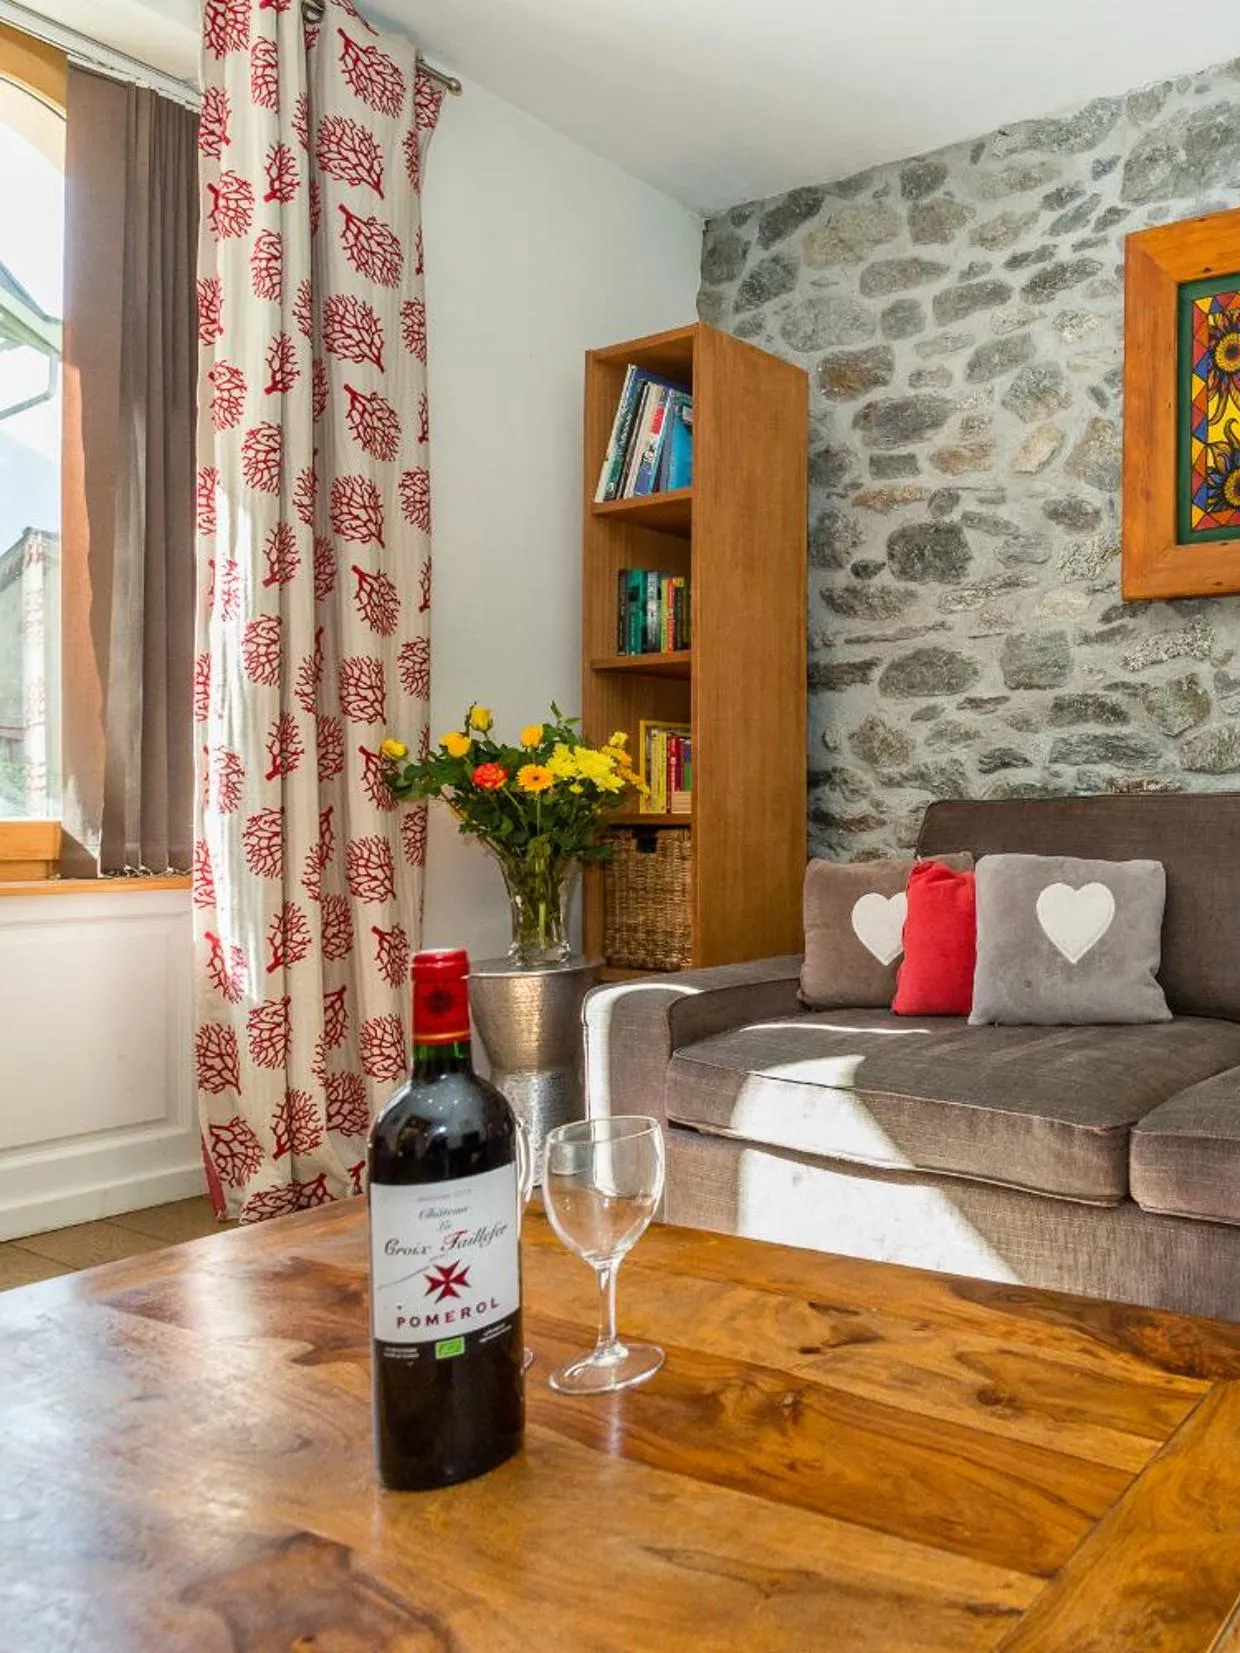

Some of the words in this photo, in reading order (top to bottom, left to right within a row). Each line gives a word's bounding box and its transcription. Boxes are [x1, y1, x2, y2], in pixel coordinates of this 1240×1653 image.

[384, 1237, 432, 1256] Croix
[440, 1223, 508, 1252] Taillefer
[396, 1299, 500, 1328] POMEROL
